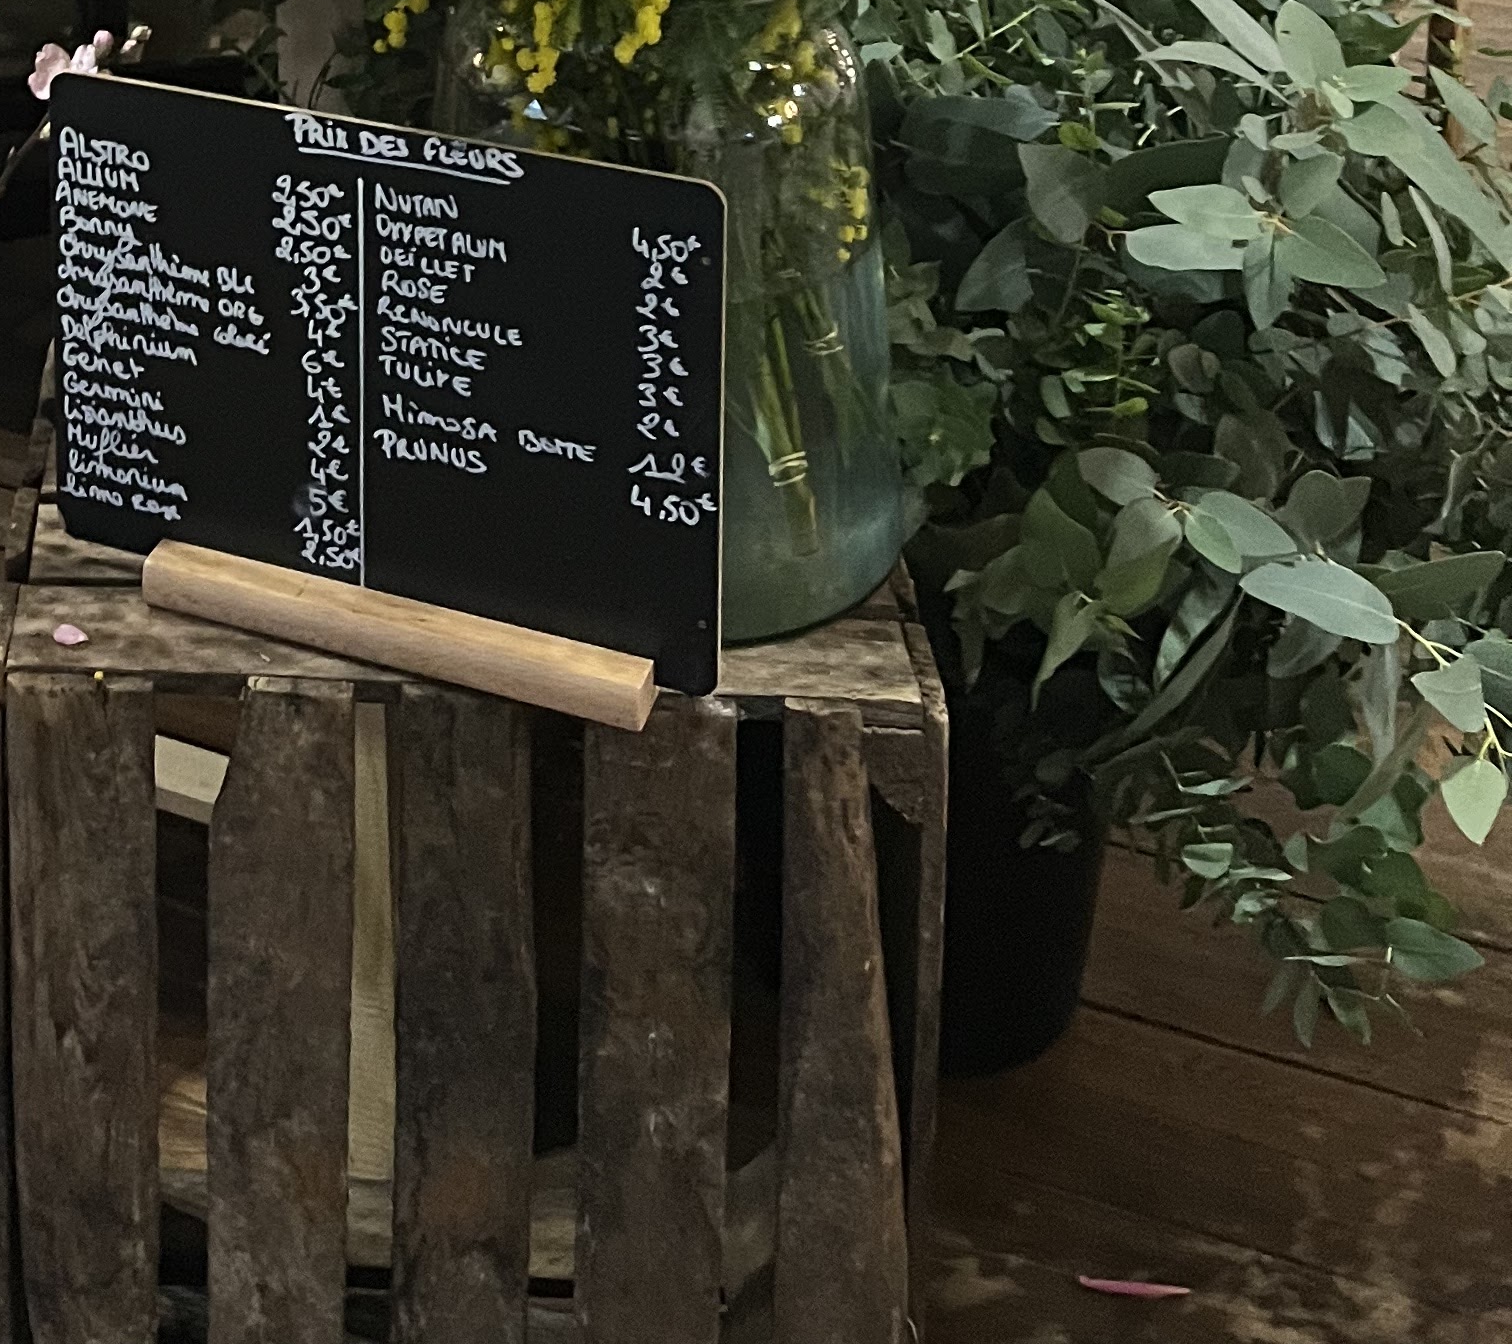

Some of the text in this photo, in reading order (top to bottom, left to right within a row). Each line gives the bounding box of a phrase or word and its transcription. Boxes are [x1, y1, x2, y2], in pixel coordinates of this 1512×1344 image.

[59, 126, 150, 171] ALSTRO
[359, 130, 409, 158] DES
[423, 137, 525, 179] FLEURS
[58, 156, 140, 192] ALLIUM
[55, 179, 159, 223] ANEMONE
[375, 183, 459, 219] NUTAN
[381, 269, 448, 304] ROSE
[377, 295, 523, 346] RENONCULE
[373, 428, 487, 474] PRUNUS
